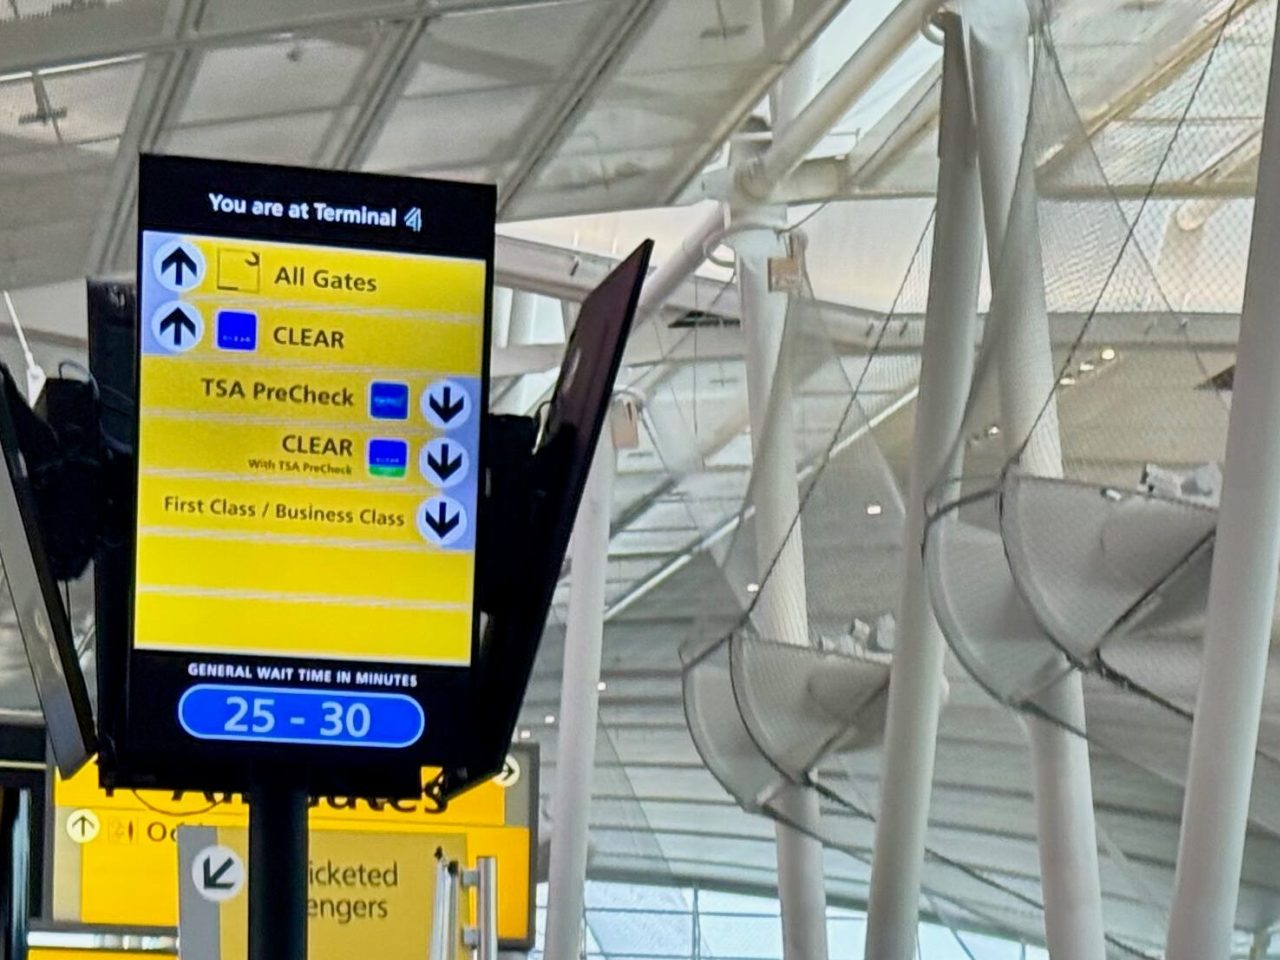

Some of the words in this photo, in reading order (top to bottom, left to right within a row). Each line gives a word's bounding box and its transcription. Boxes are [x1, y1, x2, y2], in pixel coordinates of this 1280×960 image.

[209, 193, 246, 215] You
[252, 201, 283, 218] are
[288, 202, 309, 219] at
[313, 203, 397, 228] Terminal
[403, 207, 422, 232] 4
[274, 267, 305, 287] All
[313, 270, 378, 292] Gates
[273, 326, 345, 349] CLEAR
[201, 378, 246, 399] TSA
[253, 382, 354, 407] PreCheck
[282, 434, 353, 457] CLEAR
[248, 459, 276, 471] With
[279, 460, 300, 472] TSA
[303, 462, 352, 475] PreCheck
[164, 495, 204, 513] First
[210, 498, 256, 518] Class
[262, 501, 269, 518] /
[276, 504, 354, 525] Business
[360, 507, 406, 527] Class
[188, 661, 252, 679] GENERAL
[257, 666, 293, 681] WAIT
[298, 668, 332, 683] TIME
[336, 670, 351, 684] IN
[355, 671, 418, 688] MINUTES
[224, 696, 275, 734] 25
[290, 715, 305, 726] -
[319, 702, 371, 738] 30
[309, 859, 398, 887] icketed
[308, 898, 388, 924] engers
